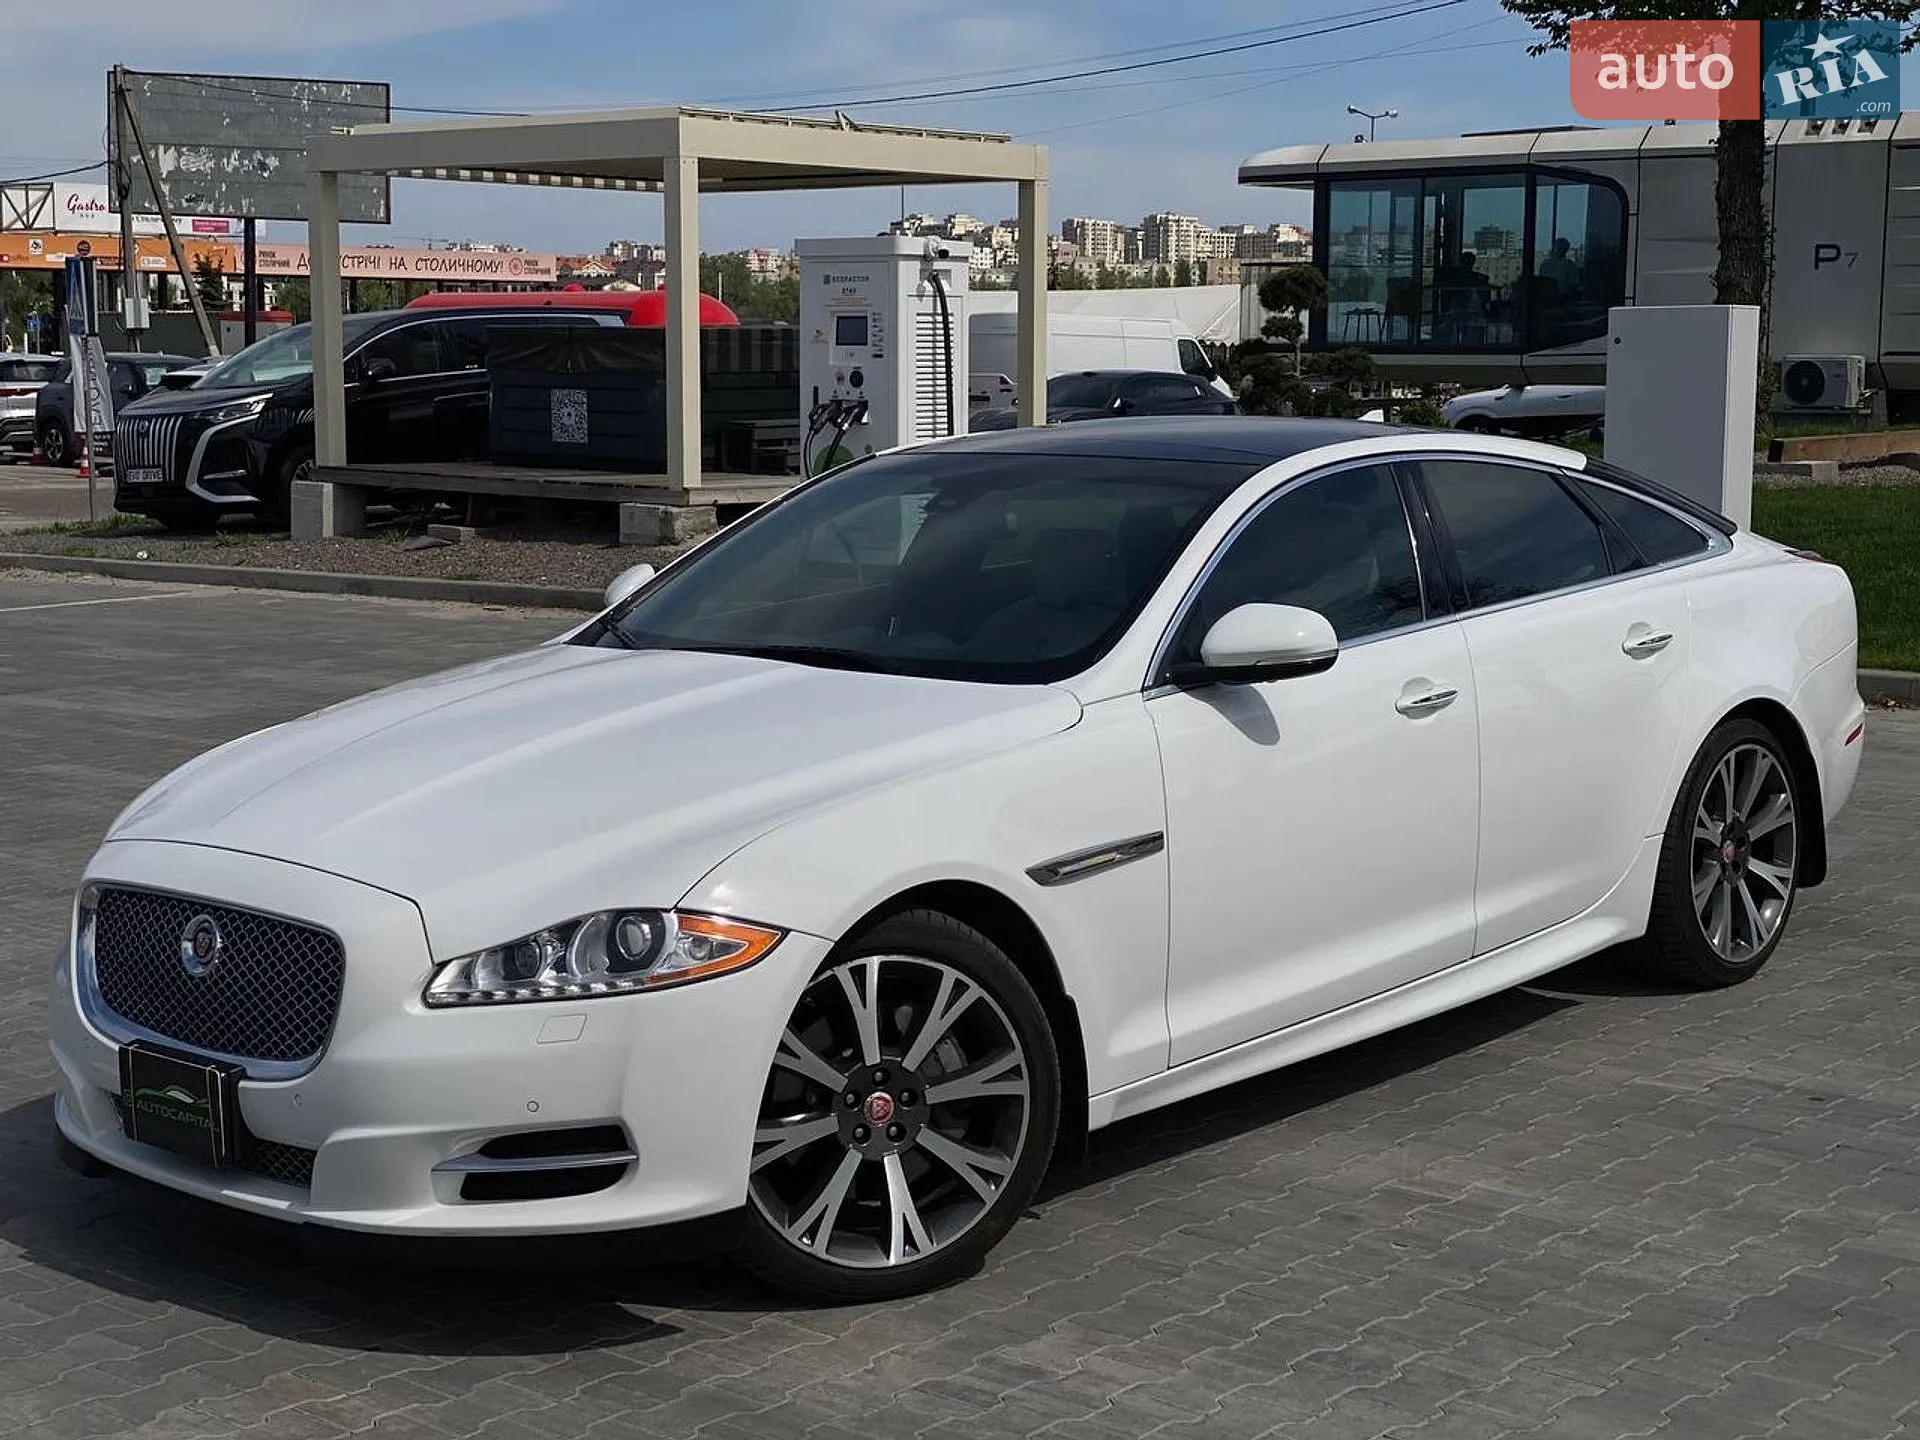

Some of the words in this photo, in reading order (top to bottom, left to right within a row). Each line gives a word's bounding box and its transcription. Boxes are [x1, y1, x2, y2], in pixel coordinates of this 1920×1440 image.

[67, 193, 105, 214] Gastro
[339, 254, 381, 269] СТРІЧІ
[389, 255, 408, 271] НА
[415, 257, 503, 274] СТОЛИЧНОМУ!
